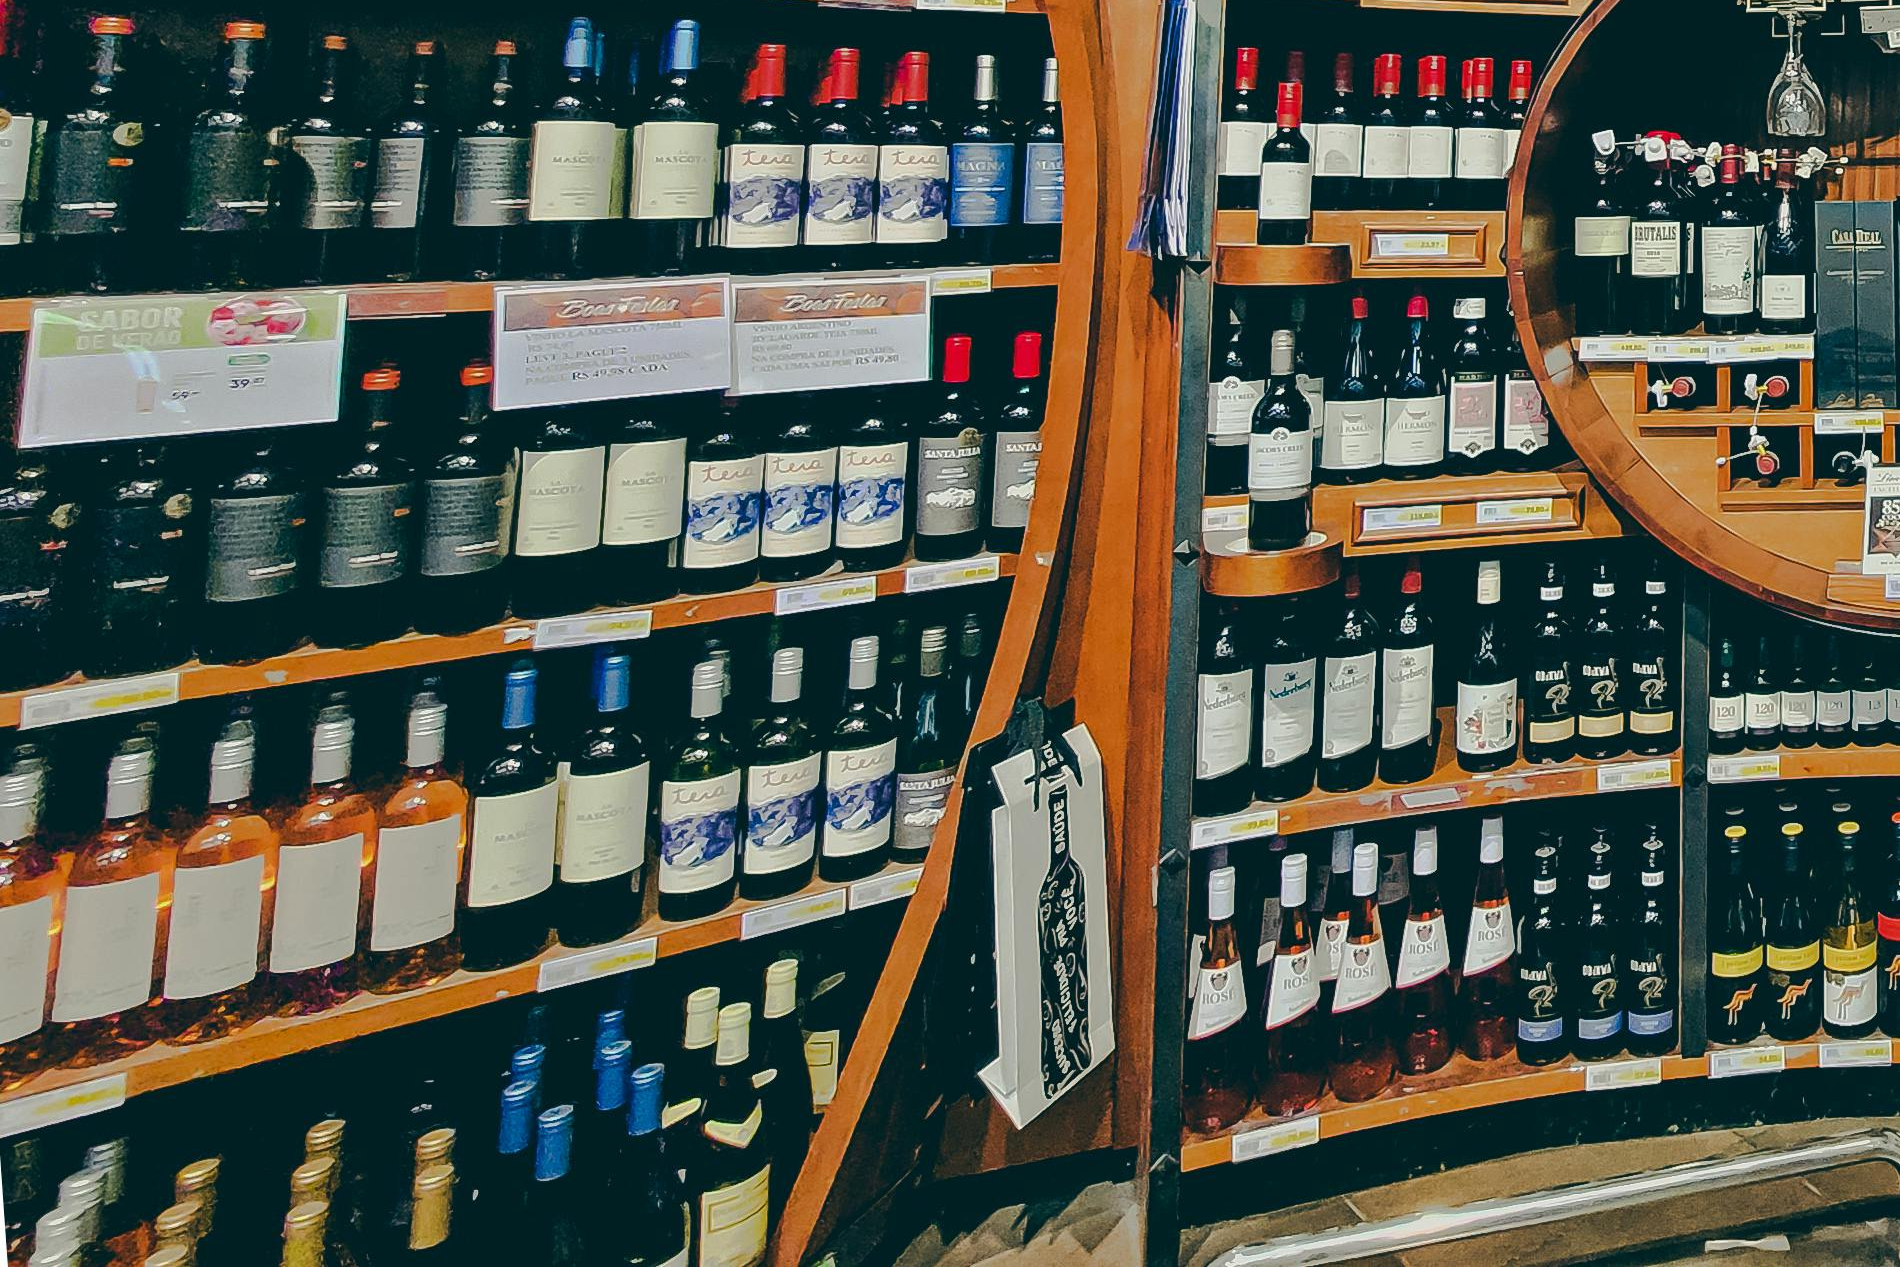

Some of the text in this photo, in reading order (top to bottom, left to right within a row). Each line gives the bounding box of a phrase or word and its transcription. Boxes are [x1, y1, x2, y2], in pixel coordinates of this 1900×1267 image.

[80, 307, 183, 332] SABOR
[76, 334, 105, 350] DE
[628, 364, 668, 373] CADA
[925, 447, 981, 459] SANTA JULIA
[1006, 442, 1037, 453] SANTA
[1716, 705, 1736, 718] 120
[1755, 703, 1775, 715] 120
[1788, 700, 1808, 713] 120
[1823, 700, 1843, 712] 120
[1053, 798, 1067, 854] SAÚDE
